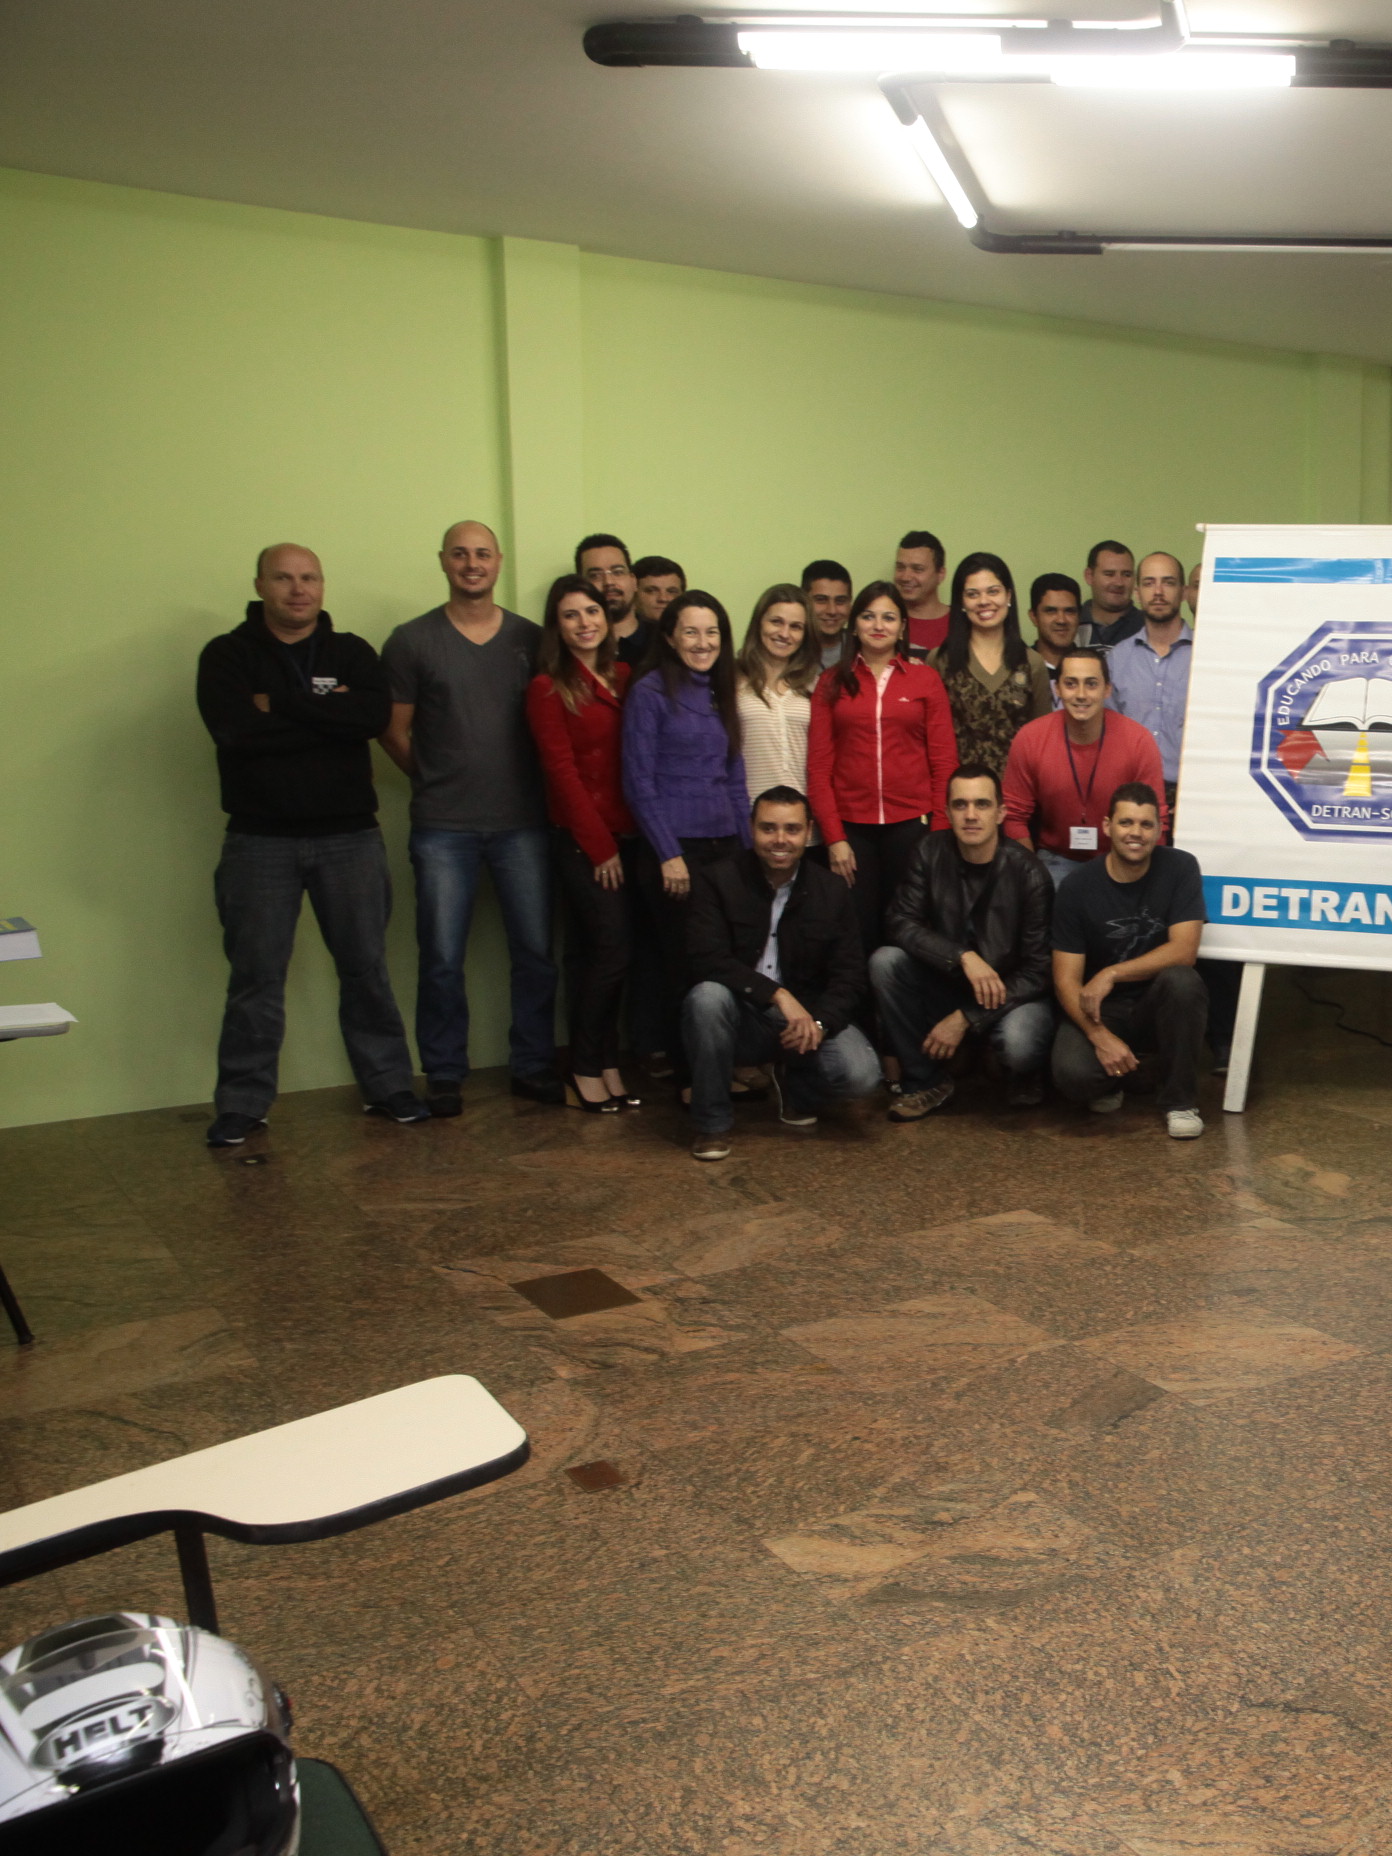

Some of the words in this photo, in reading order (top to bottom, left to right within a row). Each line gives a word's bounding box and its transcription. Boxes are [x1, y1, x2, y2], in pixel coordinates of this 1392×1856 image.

[1277, 659, 1332, 726] EDUCANDO
[1340, 651, 1380, 666] PARA
[53, 1704, 154, 1760] HELT
